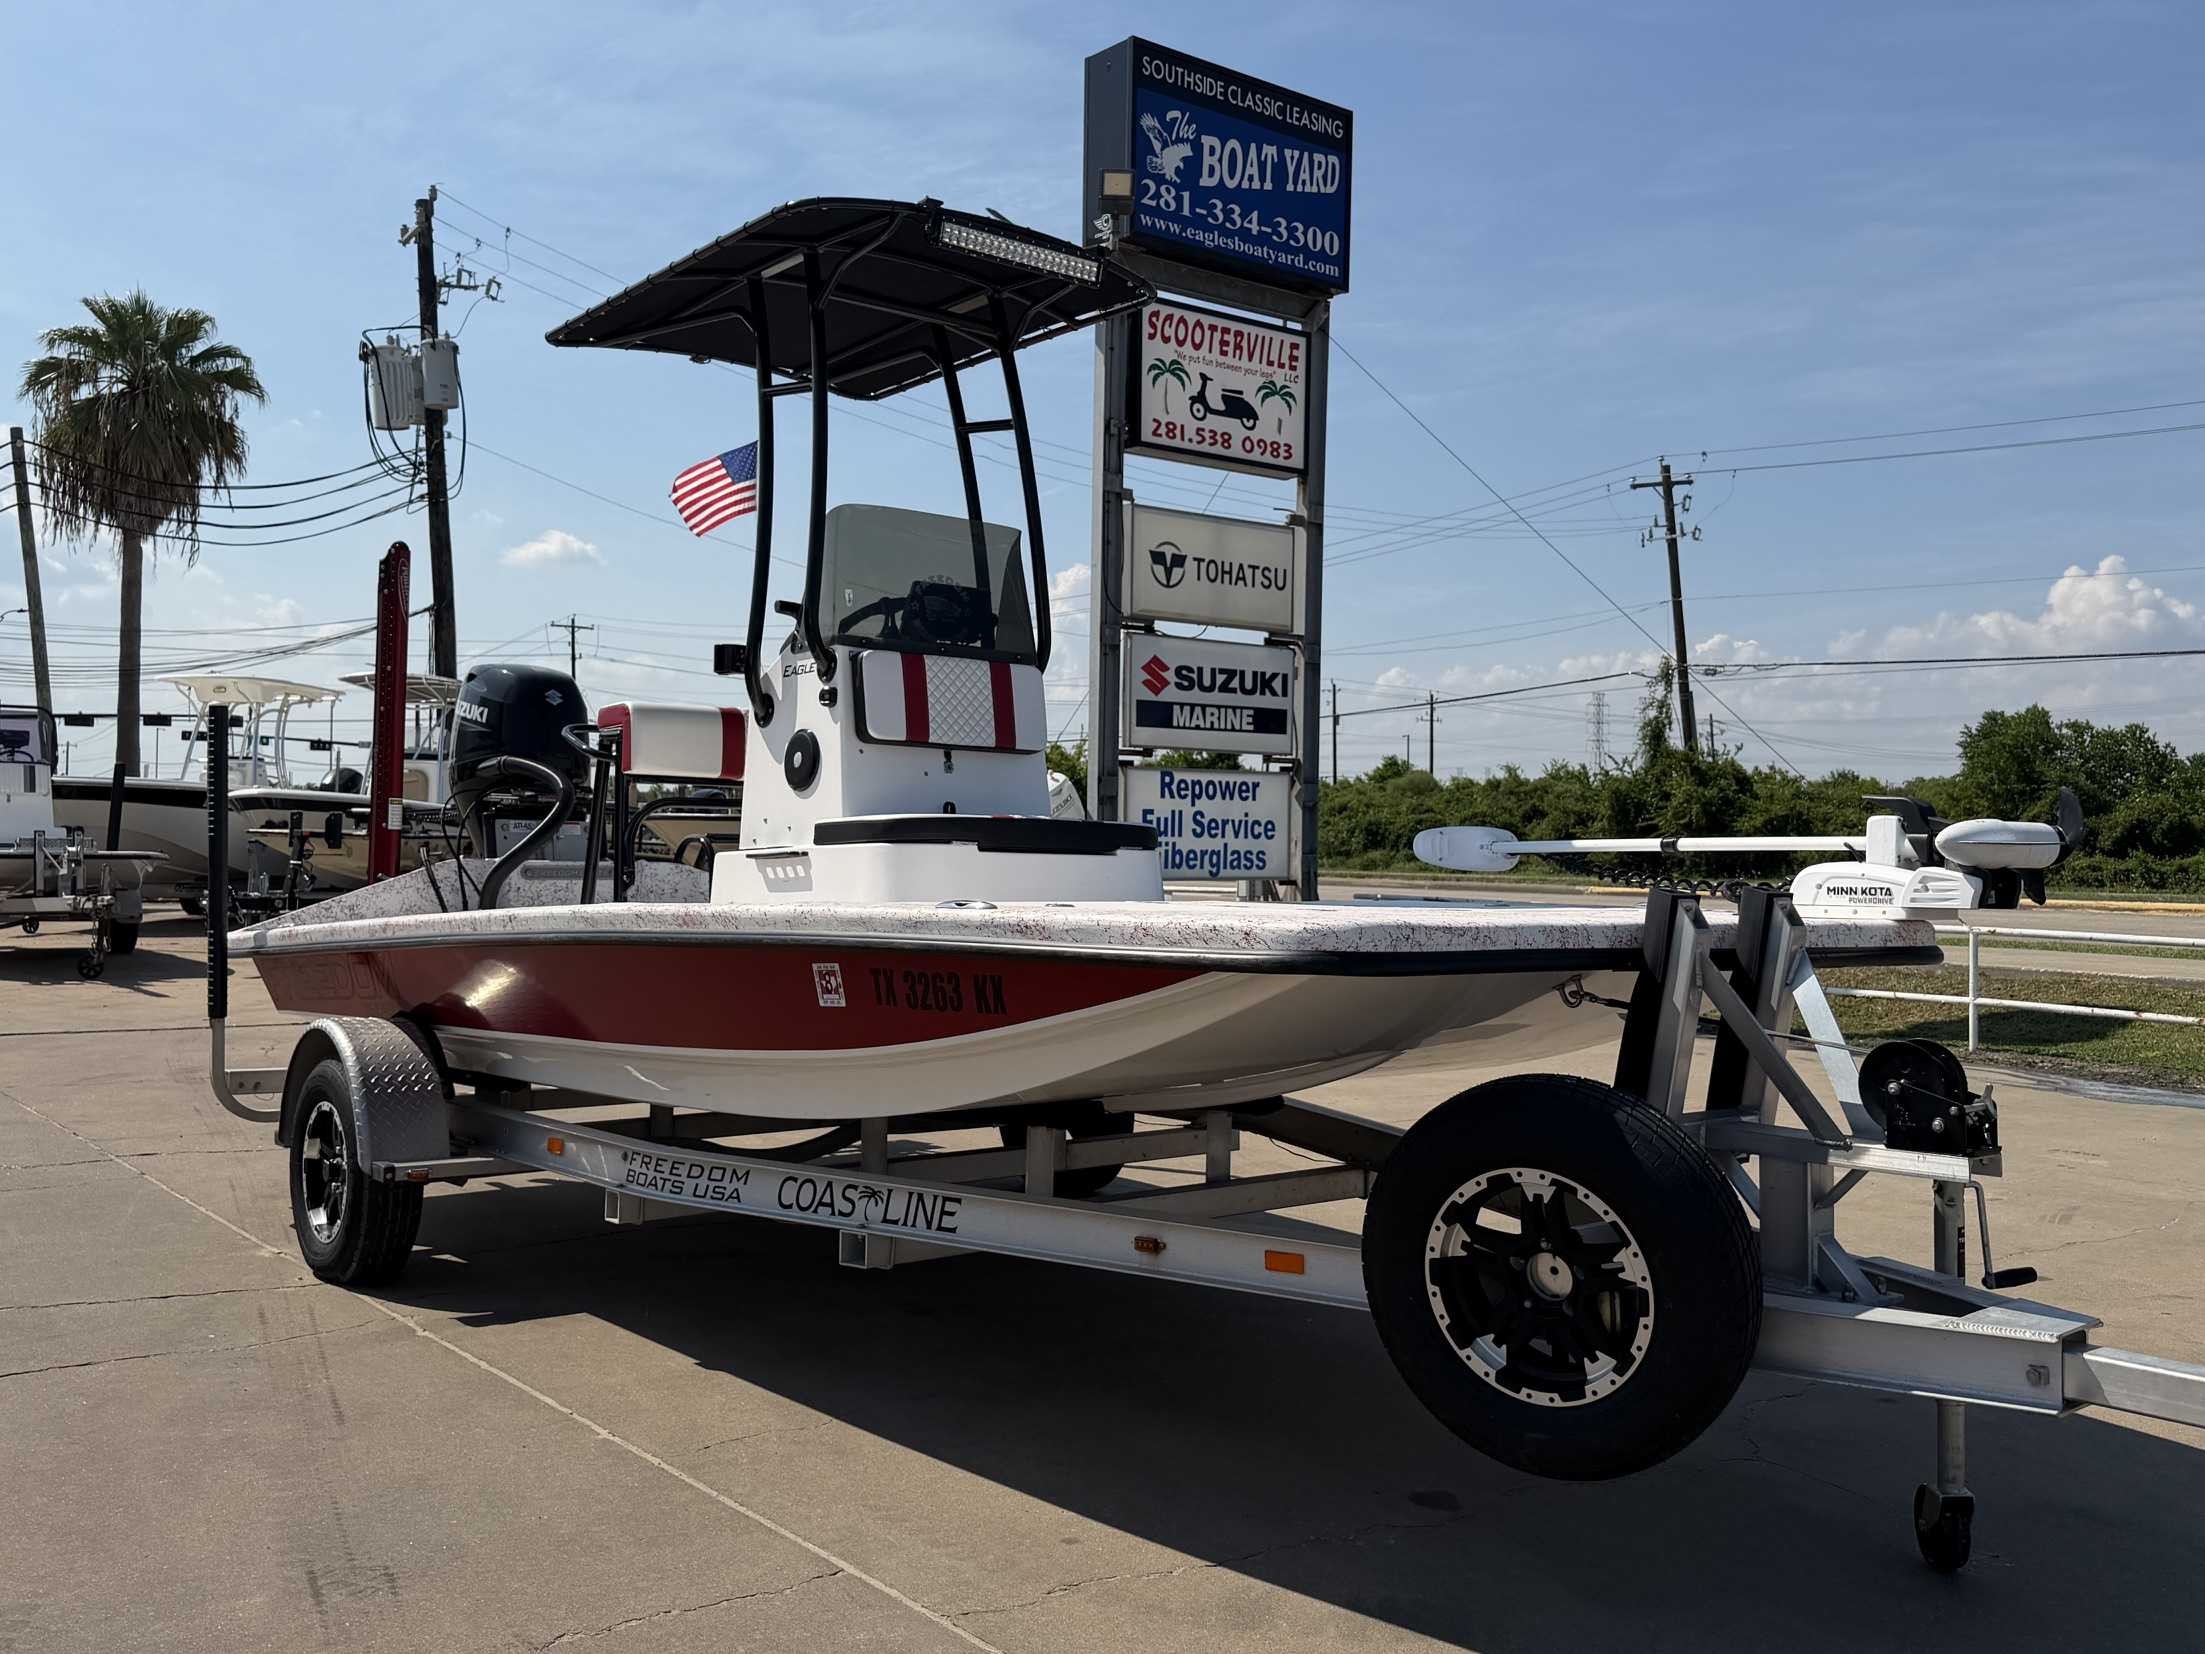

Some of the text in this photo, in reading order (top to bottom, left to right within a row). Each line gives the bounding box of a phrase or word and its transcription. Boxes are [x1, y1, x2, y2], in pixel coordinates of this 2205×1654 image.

[1142, 56, 1344, 139] SOUTHSIDE CLASSIC LEASING
[1166, 110, 1197, 140] The
[1199, 135, 1340, 194] BOAT YARD
[1140, 179, 1340, 256] 281-334-3300
[1139, 213, 1340, 277] www.eaglesboatyard.com
[1147, 309, 1300, 372] SCOOTERVILLE
[1284, 373, 1300, 383] LLC
[1152, 418, 1293, 461] 281.538 0983
[1192, 556, 1288, 592] TOHATSU
[783, 662, 818, 678] EAGLE
[1173, 664, 1289, 698] SUZUKI
[1172, 703, 1255, 732] MARINE
[1159, 770, 1261, 807] Repower
[1191, 809, 1276, 841] Service
[1157, 841, 1267, 878] iberglass
[1826, 886, 1892, 896] MINN KOTA
[869, 967, 897, 1008] TX
[902, 970, 963, 1013] 3263
[626, 1169, 742, 1204] BOATS USA
[628, 1151, 750, 1186] FREEDOM
